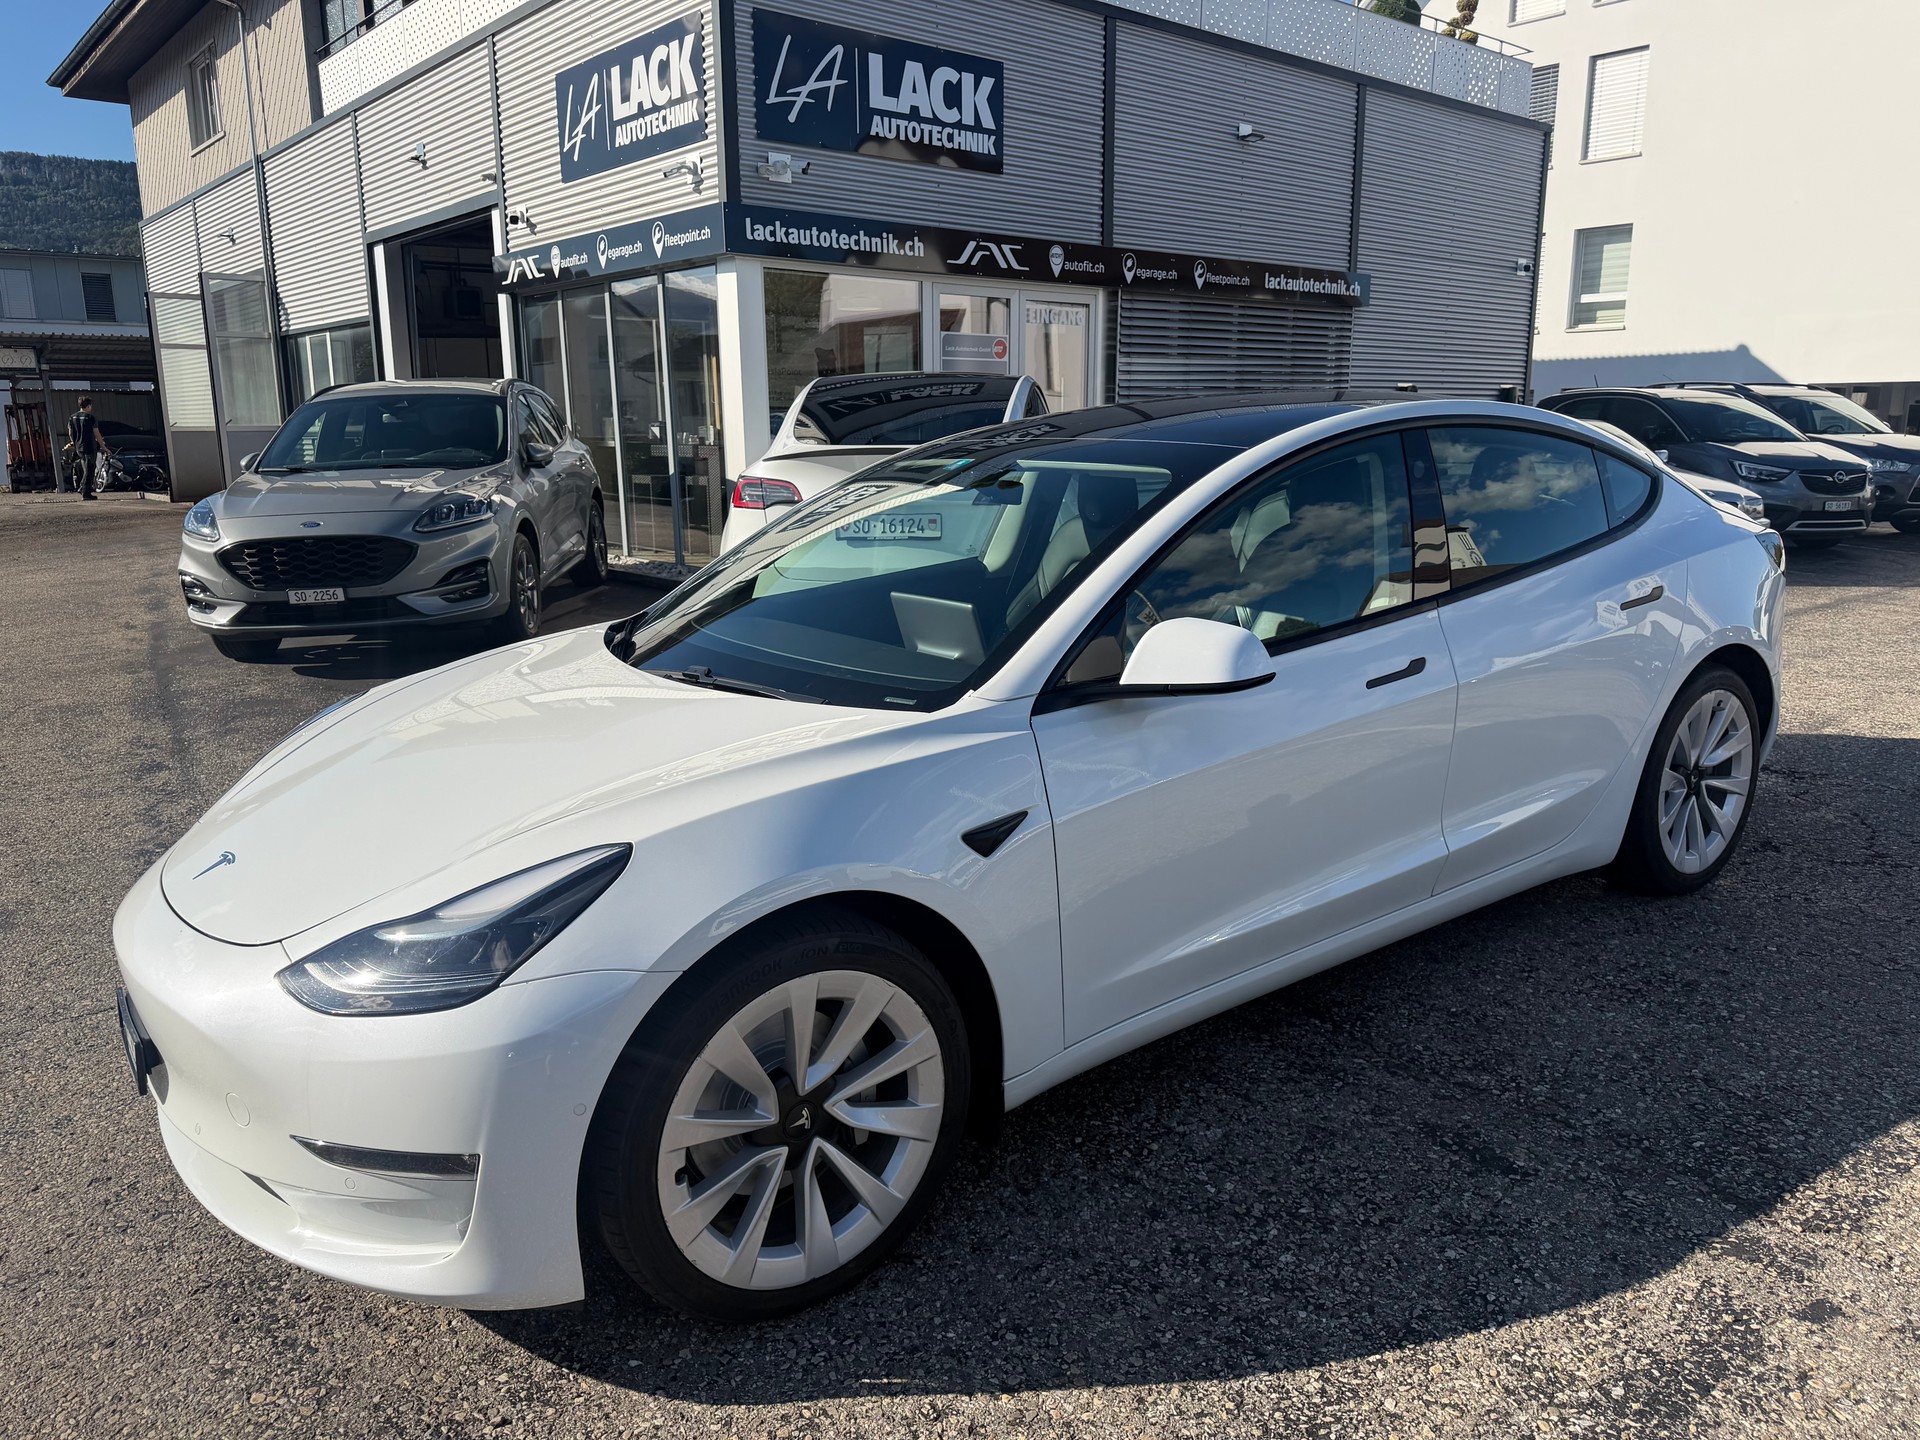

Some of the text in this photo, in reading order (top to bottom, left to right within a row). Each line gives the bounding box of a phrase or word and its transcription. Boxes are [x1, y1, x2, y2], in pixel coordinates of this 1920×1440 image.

[611, 33, 698, 121] LACK
[868, 52, 997, 130] LACK
[615, 98, 699, 147] AUTOTECHNIK
[870, 115, 996, 155] AUTOTECHNIK
[560, 252, 588, 268] autofit.ch
[607, 240, 642, 260] egarage.ch
[664, 226, 711, 247] fleetpoint.ch
[745, 218, 924, 257] lackautotechnik.ch
[1064, 260, 1105, 274] autofit.ch
[1136, 267, 1178, 281] egarage.ch
[1206, 272, 1250, 287] fleetpoint.ch
[1264, 272, 1361, 297] lackautotechnik.ch
[1028, 308, 1085, 326] EINGANG
